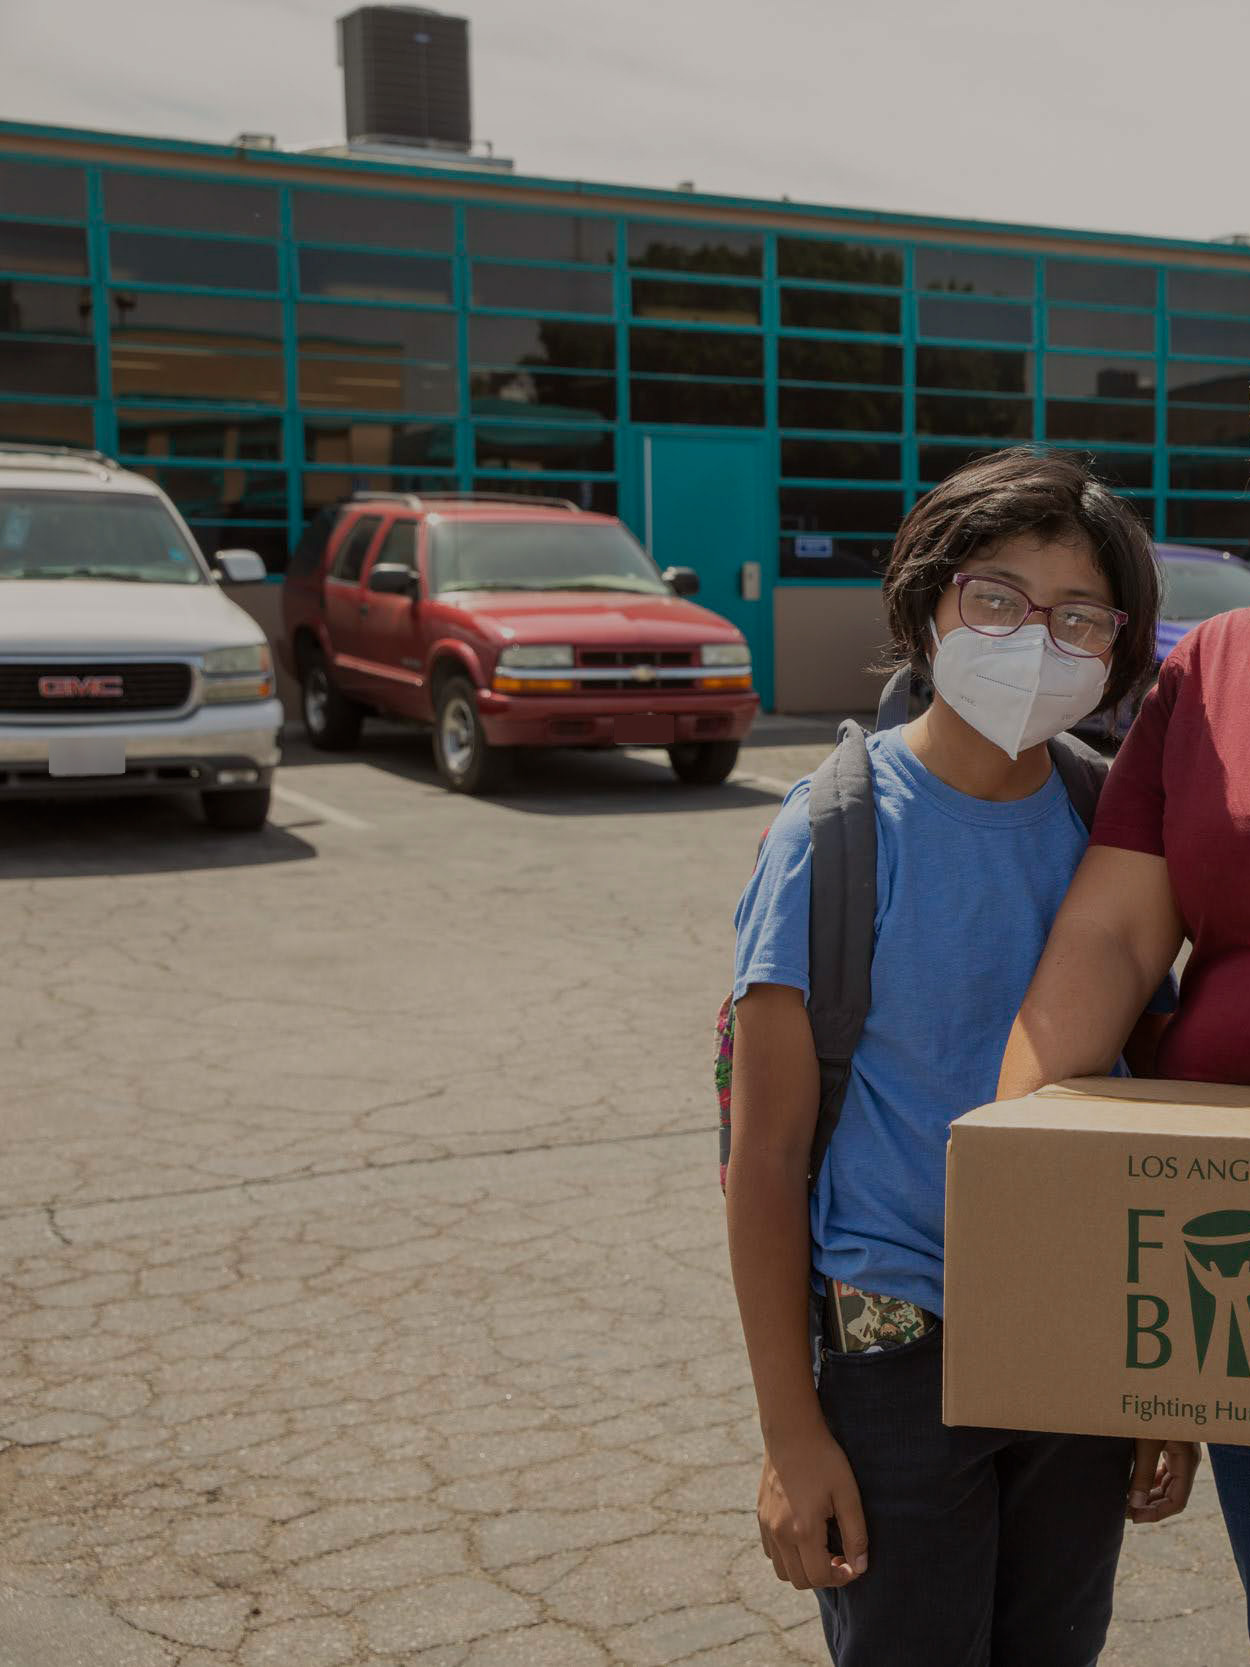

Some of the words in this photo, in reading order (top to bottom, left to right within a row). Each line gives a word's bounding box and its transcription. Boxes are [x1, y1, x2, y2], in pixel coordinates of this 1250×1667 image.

[38, 675, 124, 698] GMC
[1128, 1155, 1178, 1179] LOS
[1121, 1394, 1207, 1426] Fighting
